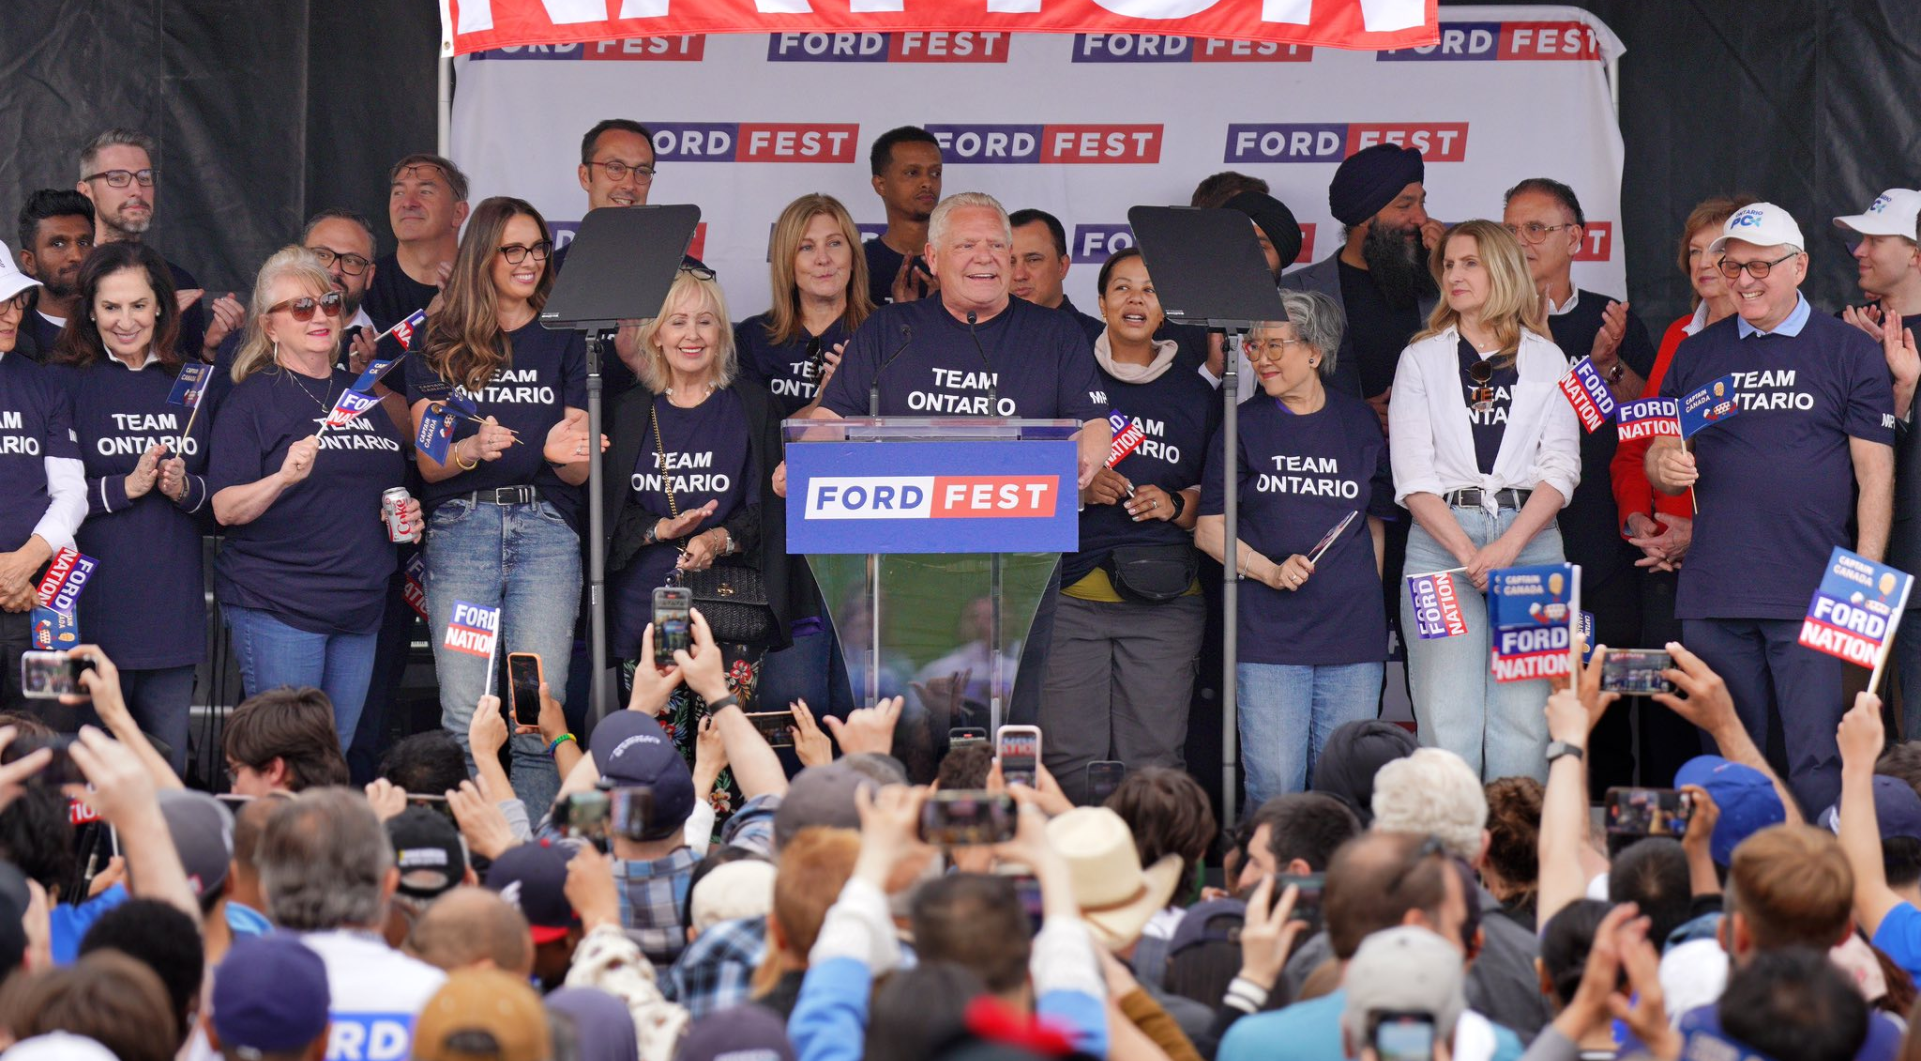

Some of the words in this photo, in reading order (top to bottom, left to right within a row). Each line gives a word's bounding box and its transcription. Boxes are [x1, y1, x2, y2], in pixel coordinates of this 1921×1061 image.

[779, 32, 883, 55] FORD
[901, 32, 1001, 56] FEST
[1083, 33, 1187, 56] FORD
[653, 131, 731, 155] ORD
[749, 131, 849, 156] FEST
[1053, 132, 1154, 157] FEST
[1235, 131, 1340, 156] FORD
[931, 367, 998, 390] TEAM
[1577, 362, 1614, 415] FORD
[1731, 370, 1796, 389] TEAM
[907, 390, 1016, 417] ONTARO
[1561, 372, 1603, 431] NATION
[1685, 388, 1707, 405] CAPTAIN
[1685, 394, 1711, 413] CANADA
[111, 413, 178, 431] TEAM
[1620, 400, 1676, 422] FORD
[419, 417, 431, 444] CAPTAIN
[424, 419, 437, 449] CANADA
[1618, 421, 1681, 441] NATION
[652, 451, 712, 469] TEAM
[1271, 455, 1338, 474] TEAM
[631, 473, 730, 493] ONTARIO
[1256, 473, 1359, 499] ONTARIO
[816, 485, 924, 511] FORD
[944, 483, 1048, 510] FEST
[1833, 564, 1873, 588] CANADA
[1838, 555, 1875, 575] CAPTAIN
[54, 558, 94, 610] FORD
[1503, 584, 1544, 596] CANADA
[1505, 574, 1541, 584] CAPTAIN
[1418, 579, 1446, 635] FORD
[1436, 572, 1465, 636] NATION
[1813, 596, 1886, 640] FORD
[1502, 626, 1568, 654] FORD
[1799, 620, 1882, 667] NATION
[1497, 653, 1571, 679] NATION
